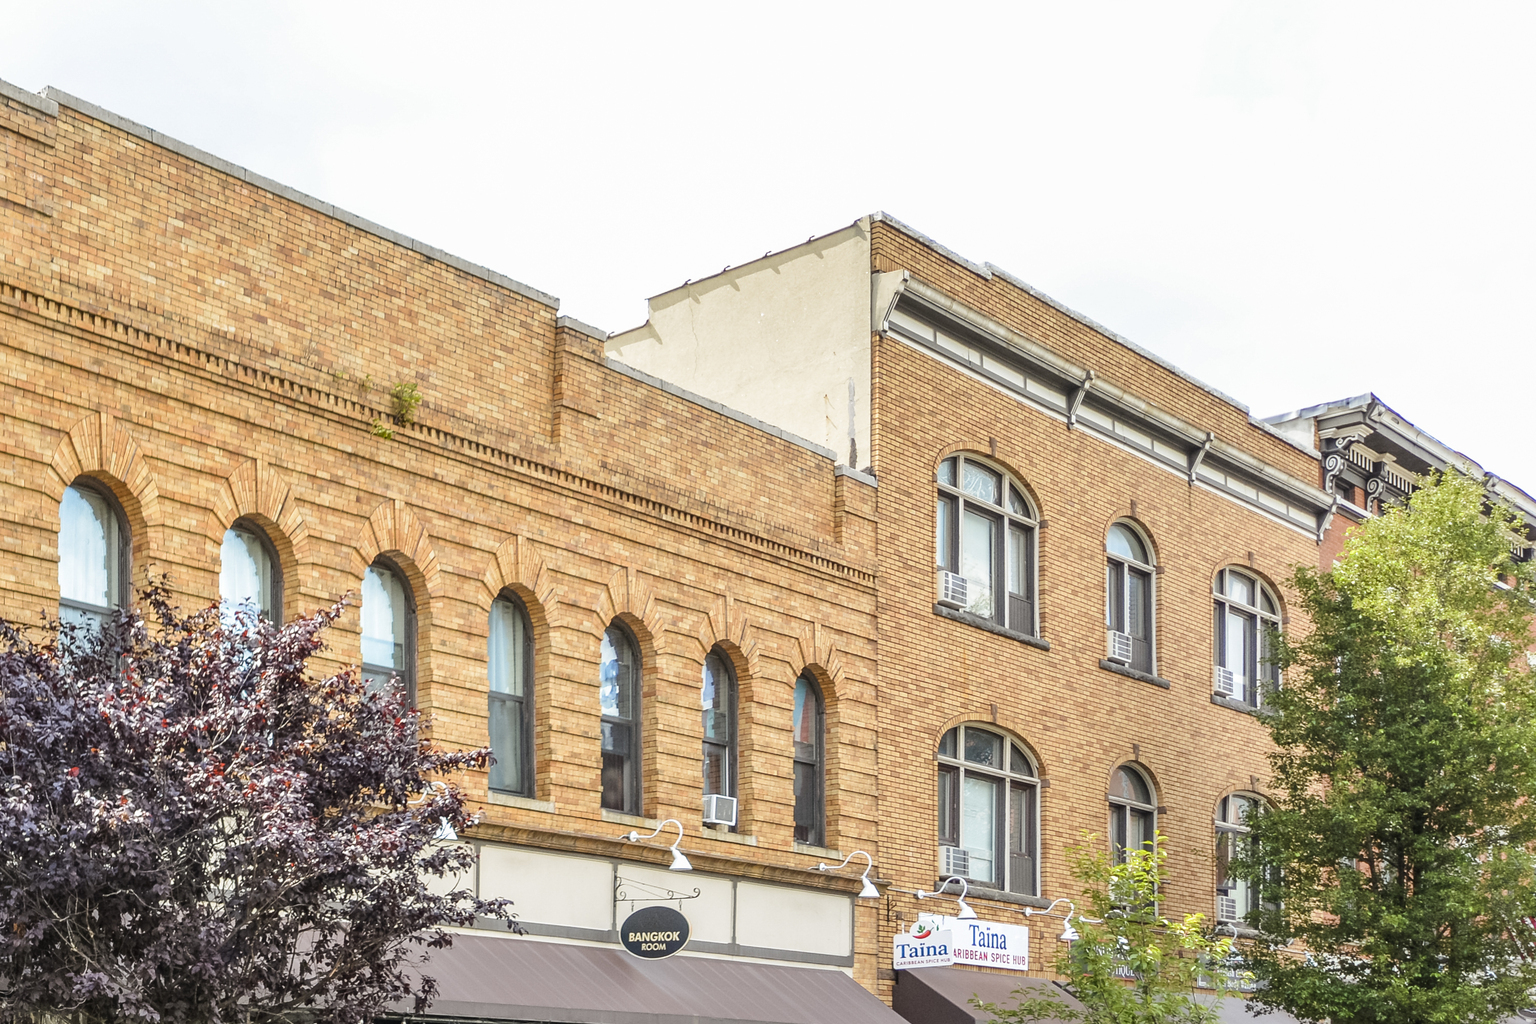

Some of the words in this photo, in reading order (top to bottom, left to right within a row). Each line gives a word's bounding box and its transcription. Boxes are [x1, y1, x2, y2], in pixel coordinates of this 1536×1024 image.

[629, 931, 680, 942] BANGKOK
[969, 924, 1007, 950] Taïna
[641, 943, 666, 951] ROOM
[896, 943, 948, 958] Taïna
[953, 949, 988, 961] ARIBBEAN
[991, 952, 1010, 964] SPICE
[1013, 955, 1026, 965] HUB
